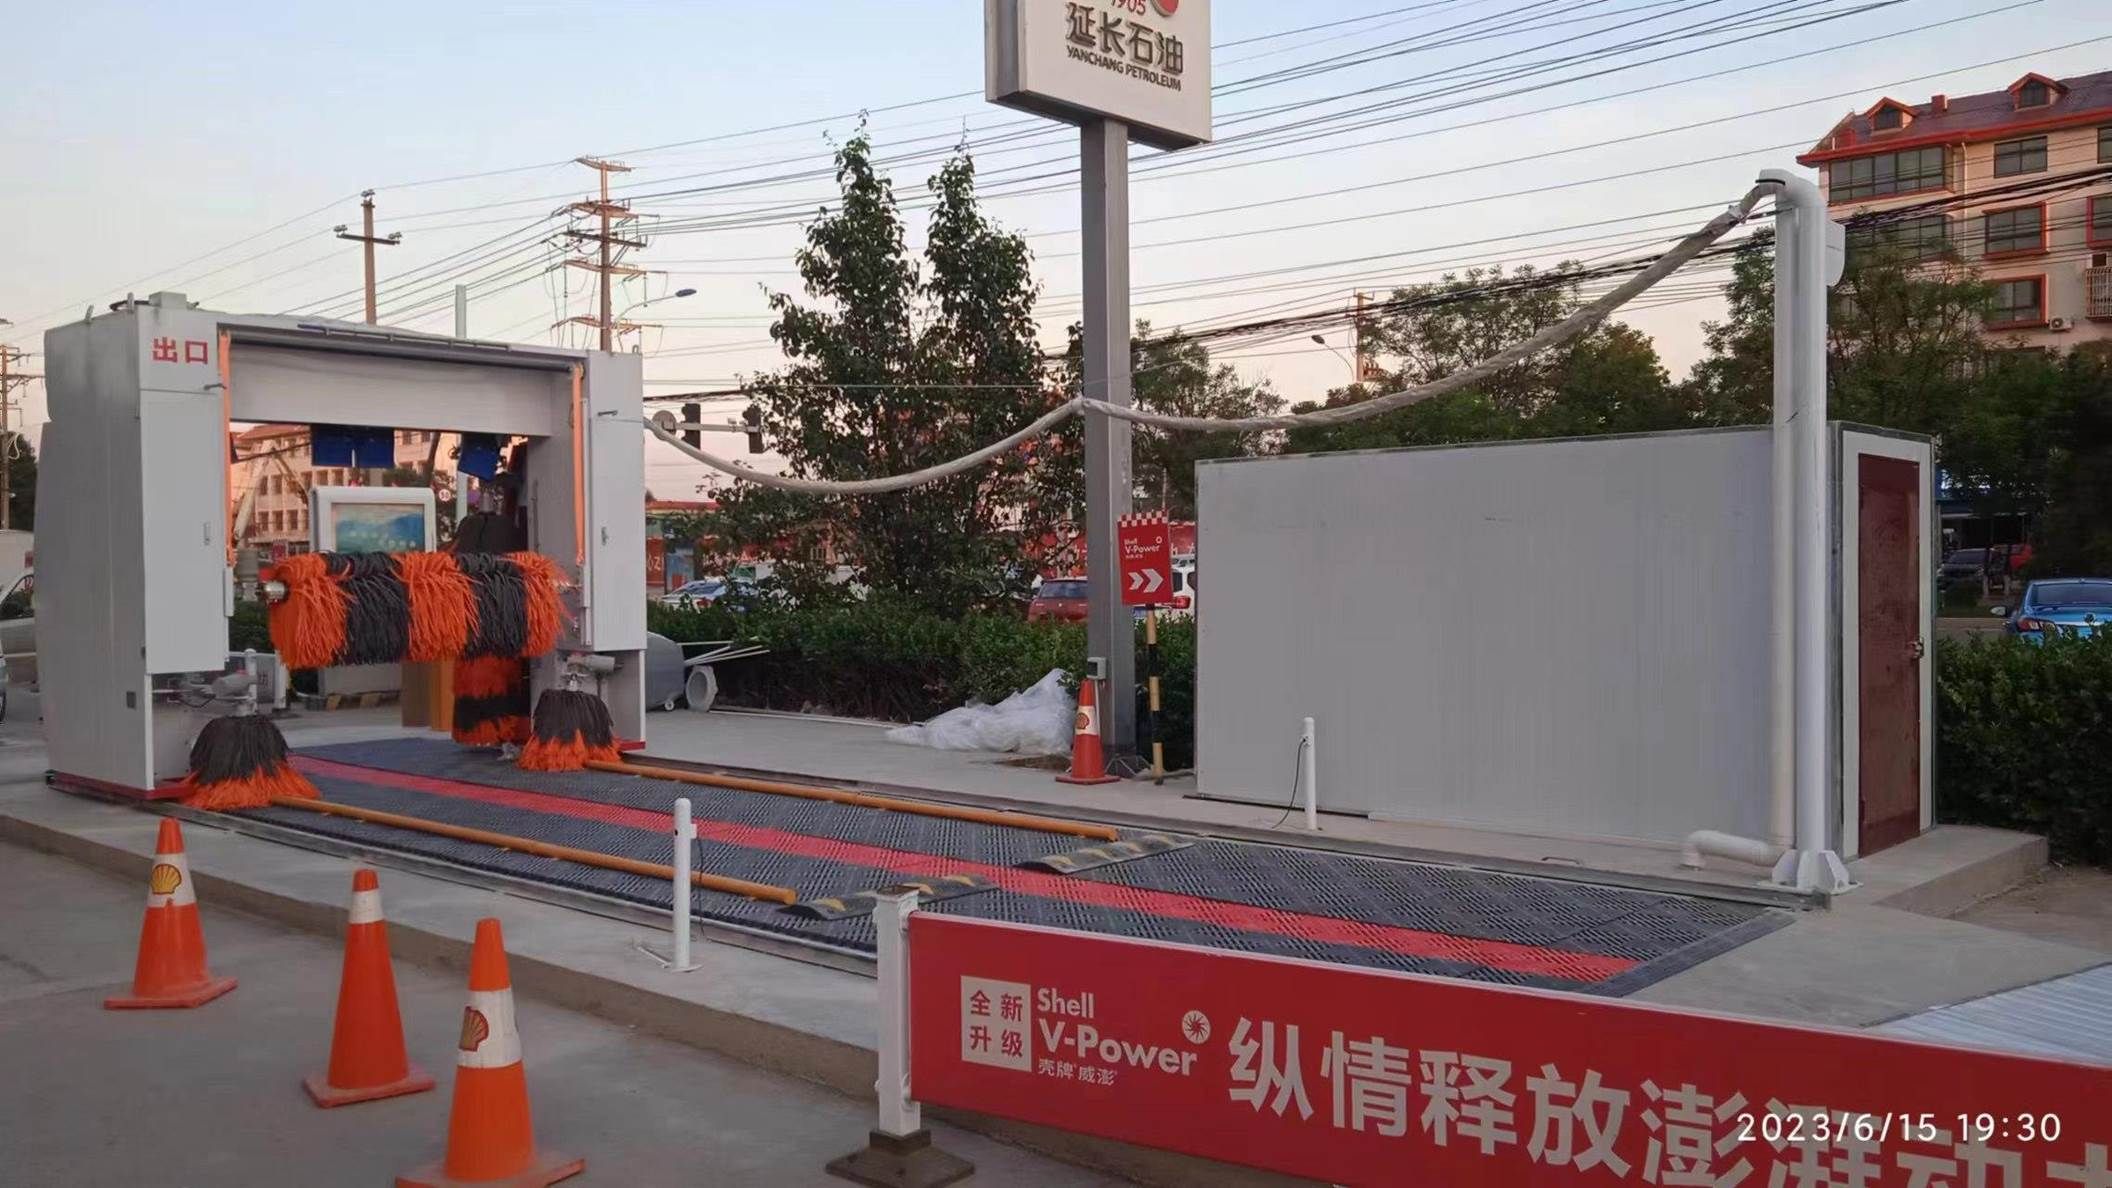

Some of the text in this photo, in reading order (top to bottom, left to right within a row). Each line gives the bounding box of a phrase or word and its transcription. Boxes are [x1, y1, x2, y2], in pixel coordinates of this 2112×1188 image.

[1066, 2, 1183, 75] 延长石油
[1066, 45, 1182, 91] YANCHANG PETROLEUM
[153, 337, 208, 365] 出口
[1125, 544, 1160, 554] V-Power
[970, 990, 1023, 1022] 全新
[1037, 987, 1095, 1019] Shell
[970, 1025, 1023, 1058] 升级
[1038, 1018, 1198, 1076] V-Power
